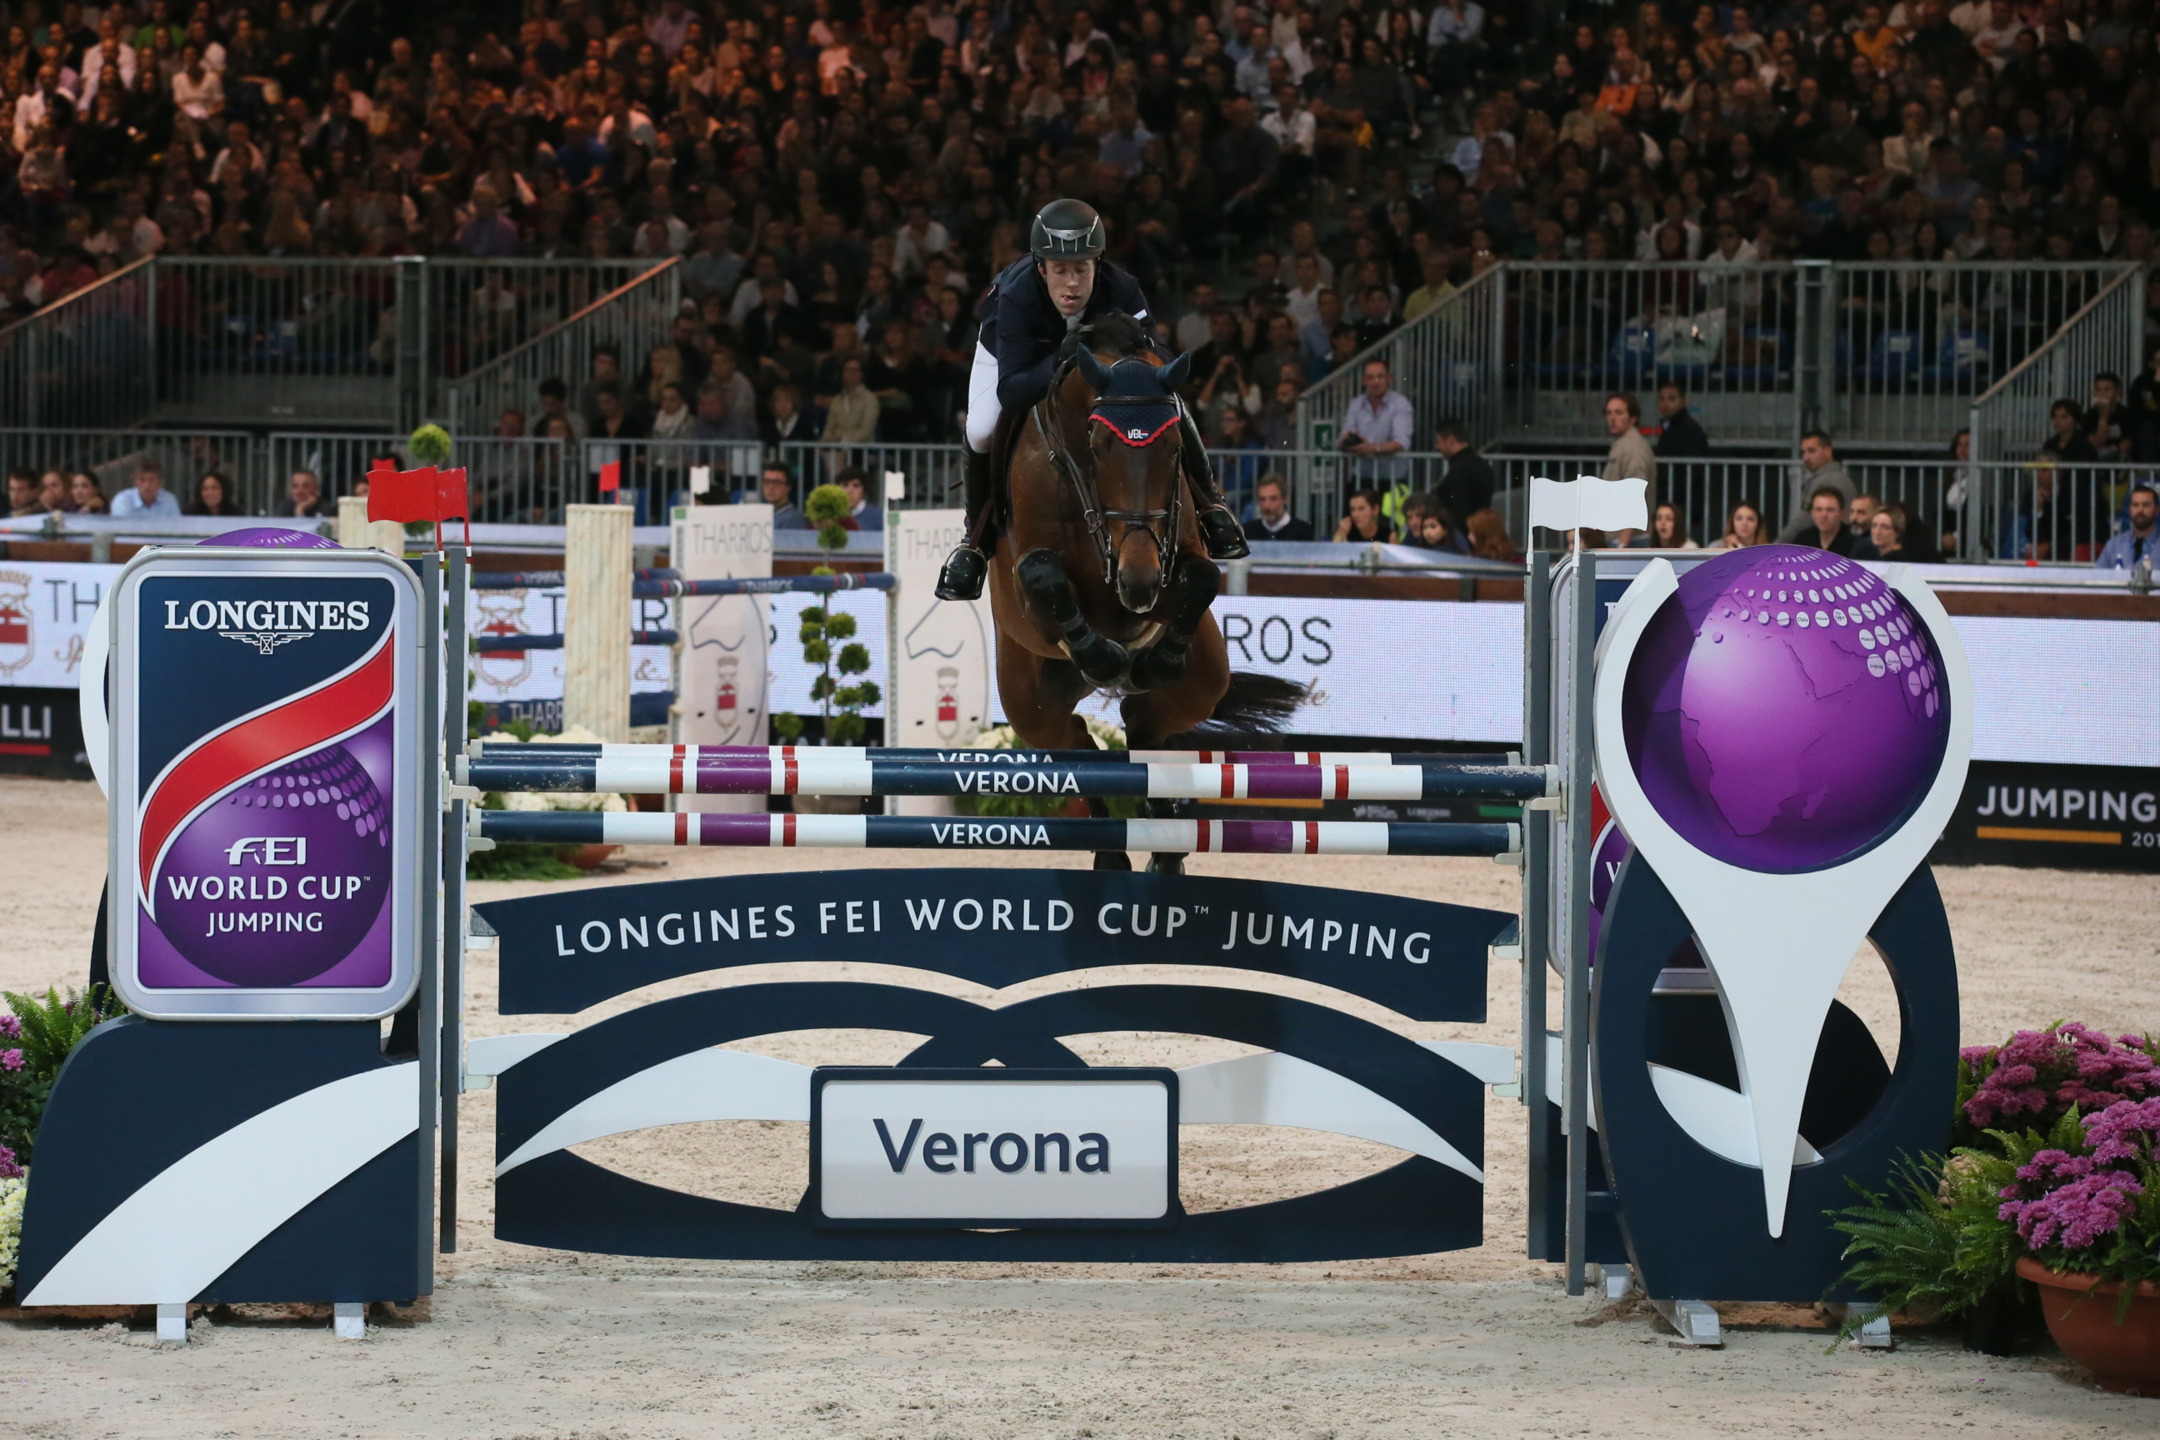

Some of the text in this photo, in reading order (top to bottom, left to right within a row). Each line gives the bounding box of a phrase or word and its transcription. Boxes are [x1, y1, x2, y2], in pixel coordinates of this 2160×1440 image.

[693, 522, 773, 554] THARROS
[164, 600, 370, 631] LONGINES
[954, 771, 1081, 794] VERONA
[1977, 785, 2158, 823] JUMPING
[931, 823, 1051, 846] VERONA
[223, 837, 307, 866] FEI
[167, 876, 288, 901] WORLD
[206, 912, 324, 938] JUMPING
[555, 904, 796, 957] LONGINES
[819, 900, 882, 935] FEI
[904, 898, 1075, 932] WORLD
[1221, 910, 1432, 965] JUMPING
[872, 1118, 1111, 1174] Verona
